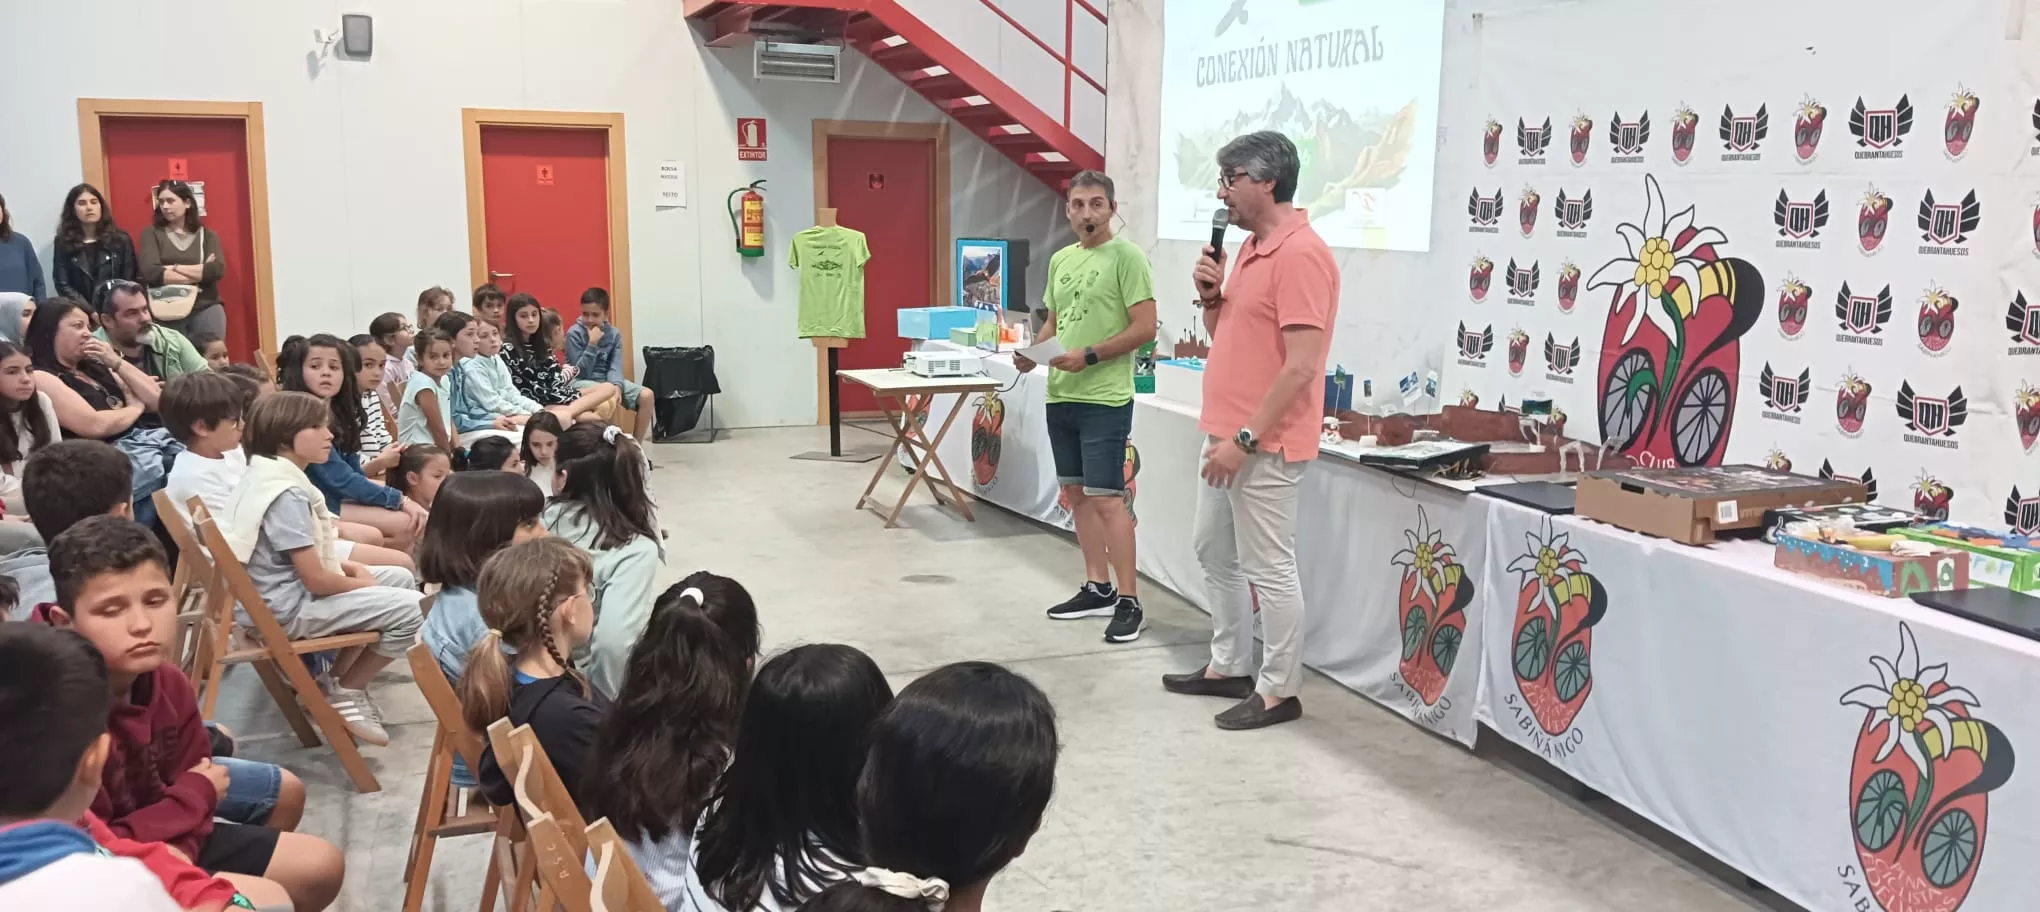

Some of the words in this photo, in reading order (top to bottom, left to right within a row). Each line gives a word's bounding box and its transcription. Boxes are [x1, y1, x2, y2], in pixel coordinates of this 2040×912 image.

[1196, 35, 1279, 88] CONEXIÓN
[1285, 25, 1384, 74] NATURAL
[739, 150, 766, 160] EXTINTOR
[1854, 150, 1903, 160] QUEBRANTAHUESOS
[1903, 433, 1959, 450] QUEBRANTAHUESOS
[1503, 693, 1584, 758] SABIÑÁNIGO
